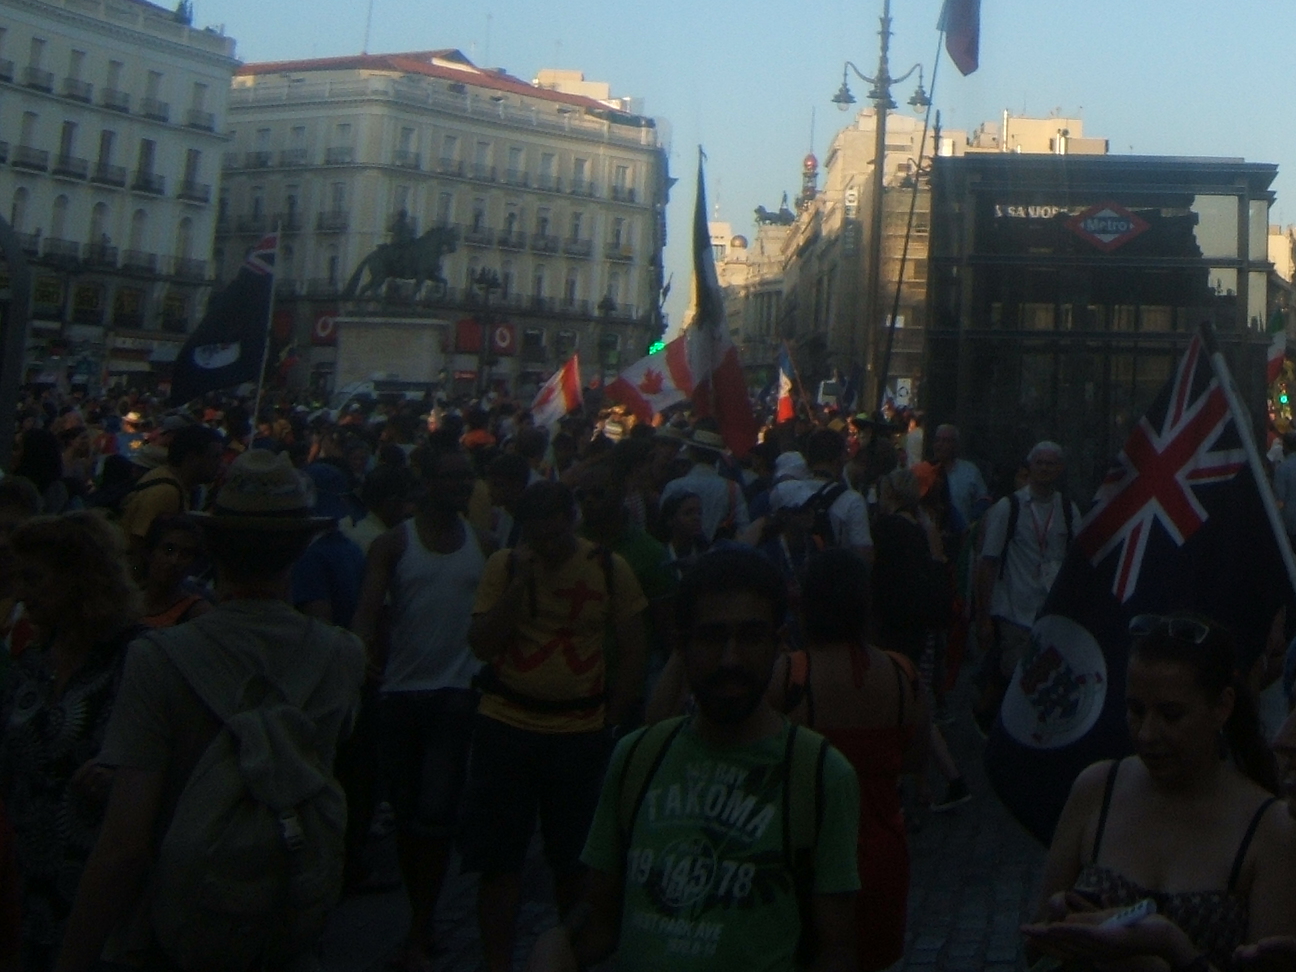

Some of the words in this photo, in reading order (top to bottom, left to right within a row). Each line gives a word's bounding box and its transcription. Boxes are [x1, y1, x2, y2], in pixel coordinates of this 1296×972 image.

[1086, 218, 1128, 232] Metro
[645, 781, 776, 840] TAKOMA
[717, 860, 756, 897] 78
